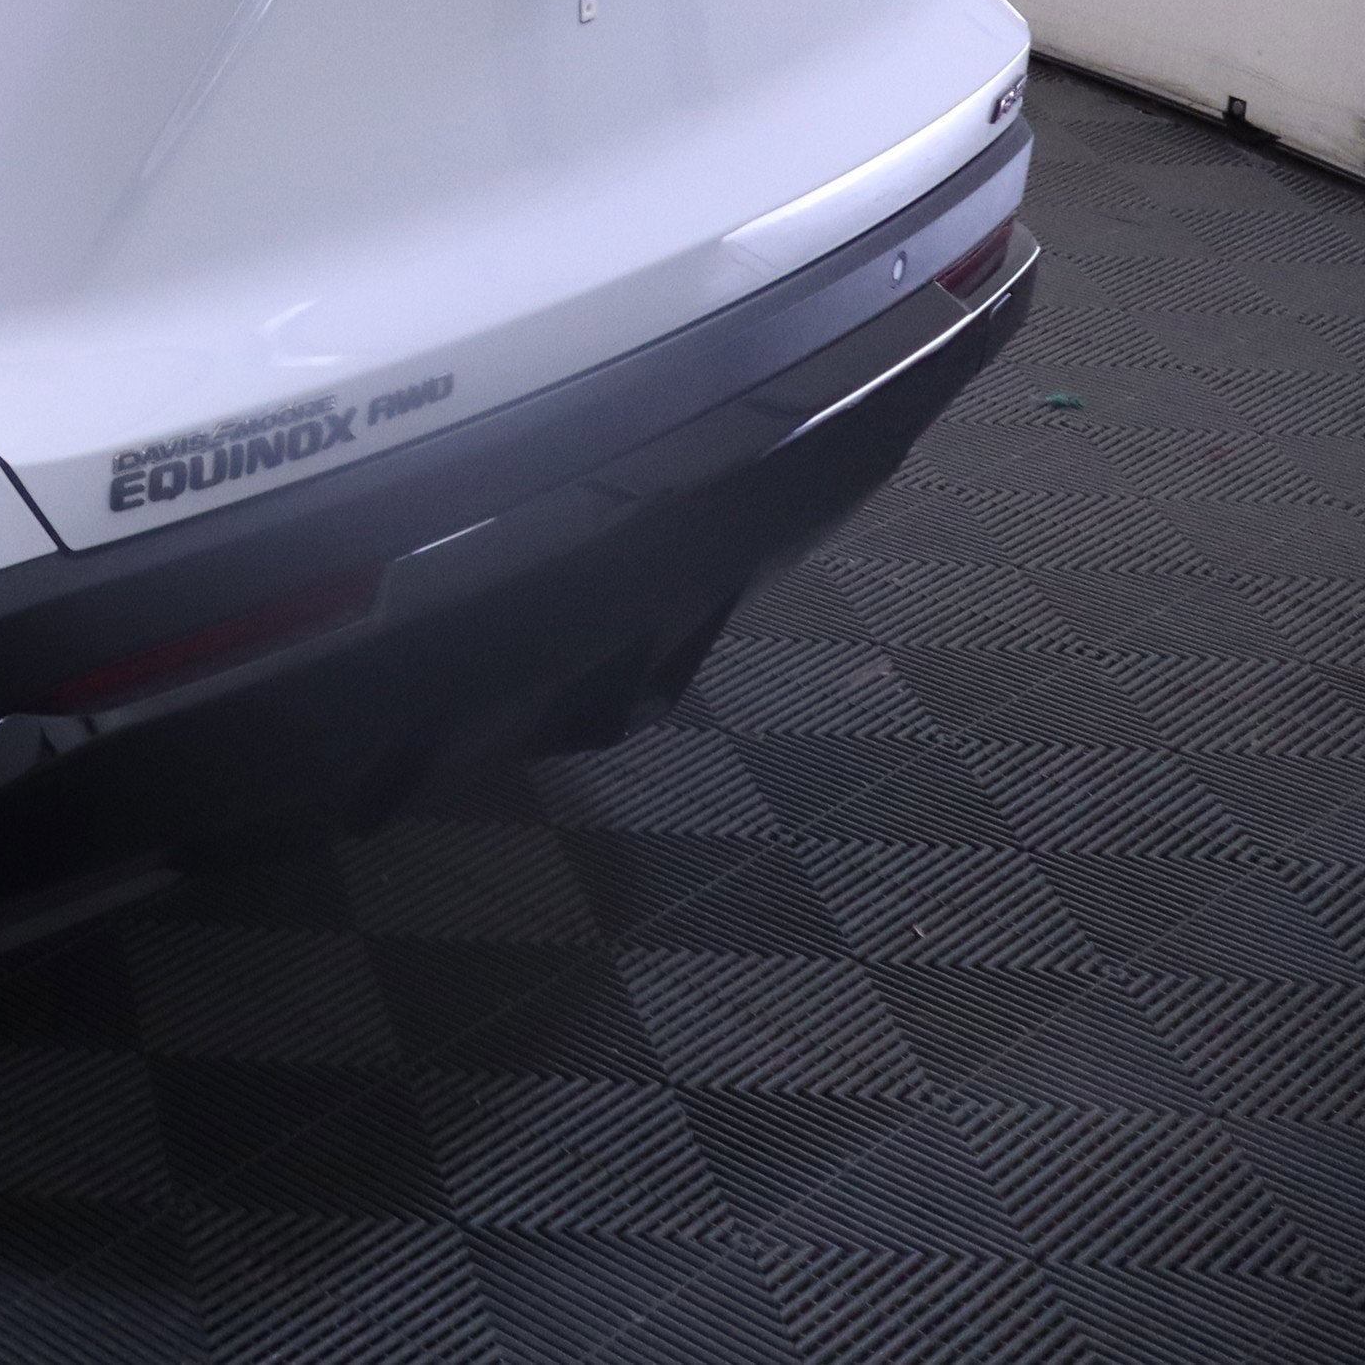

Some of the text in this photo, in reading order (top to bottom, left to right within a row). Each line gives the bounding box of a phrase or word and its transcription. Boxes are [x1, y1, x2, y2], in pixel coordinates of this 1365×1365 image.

[109, 370, 456, 512] EQUINOX AWD
[112, 392, 337, 475] DAVIS MOORE
